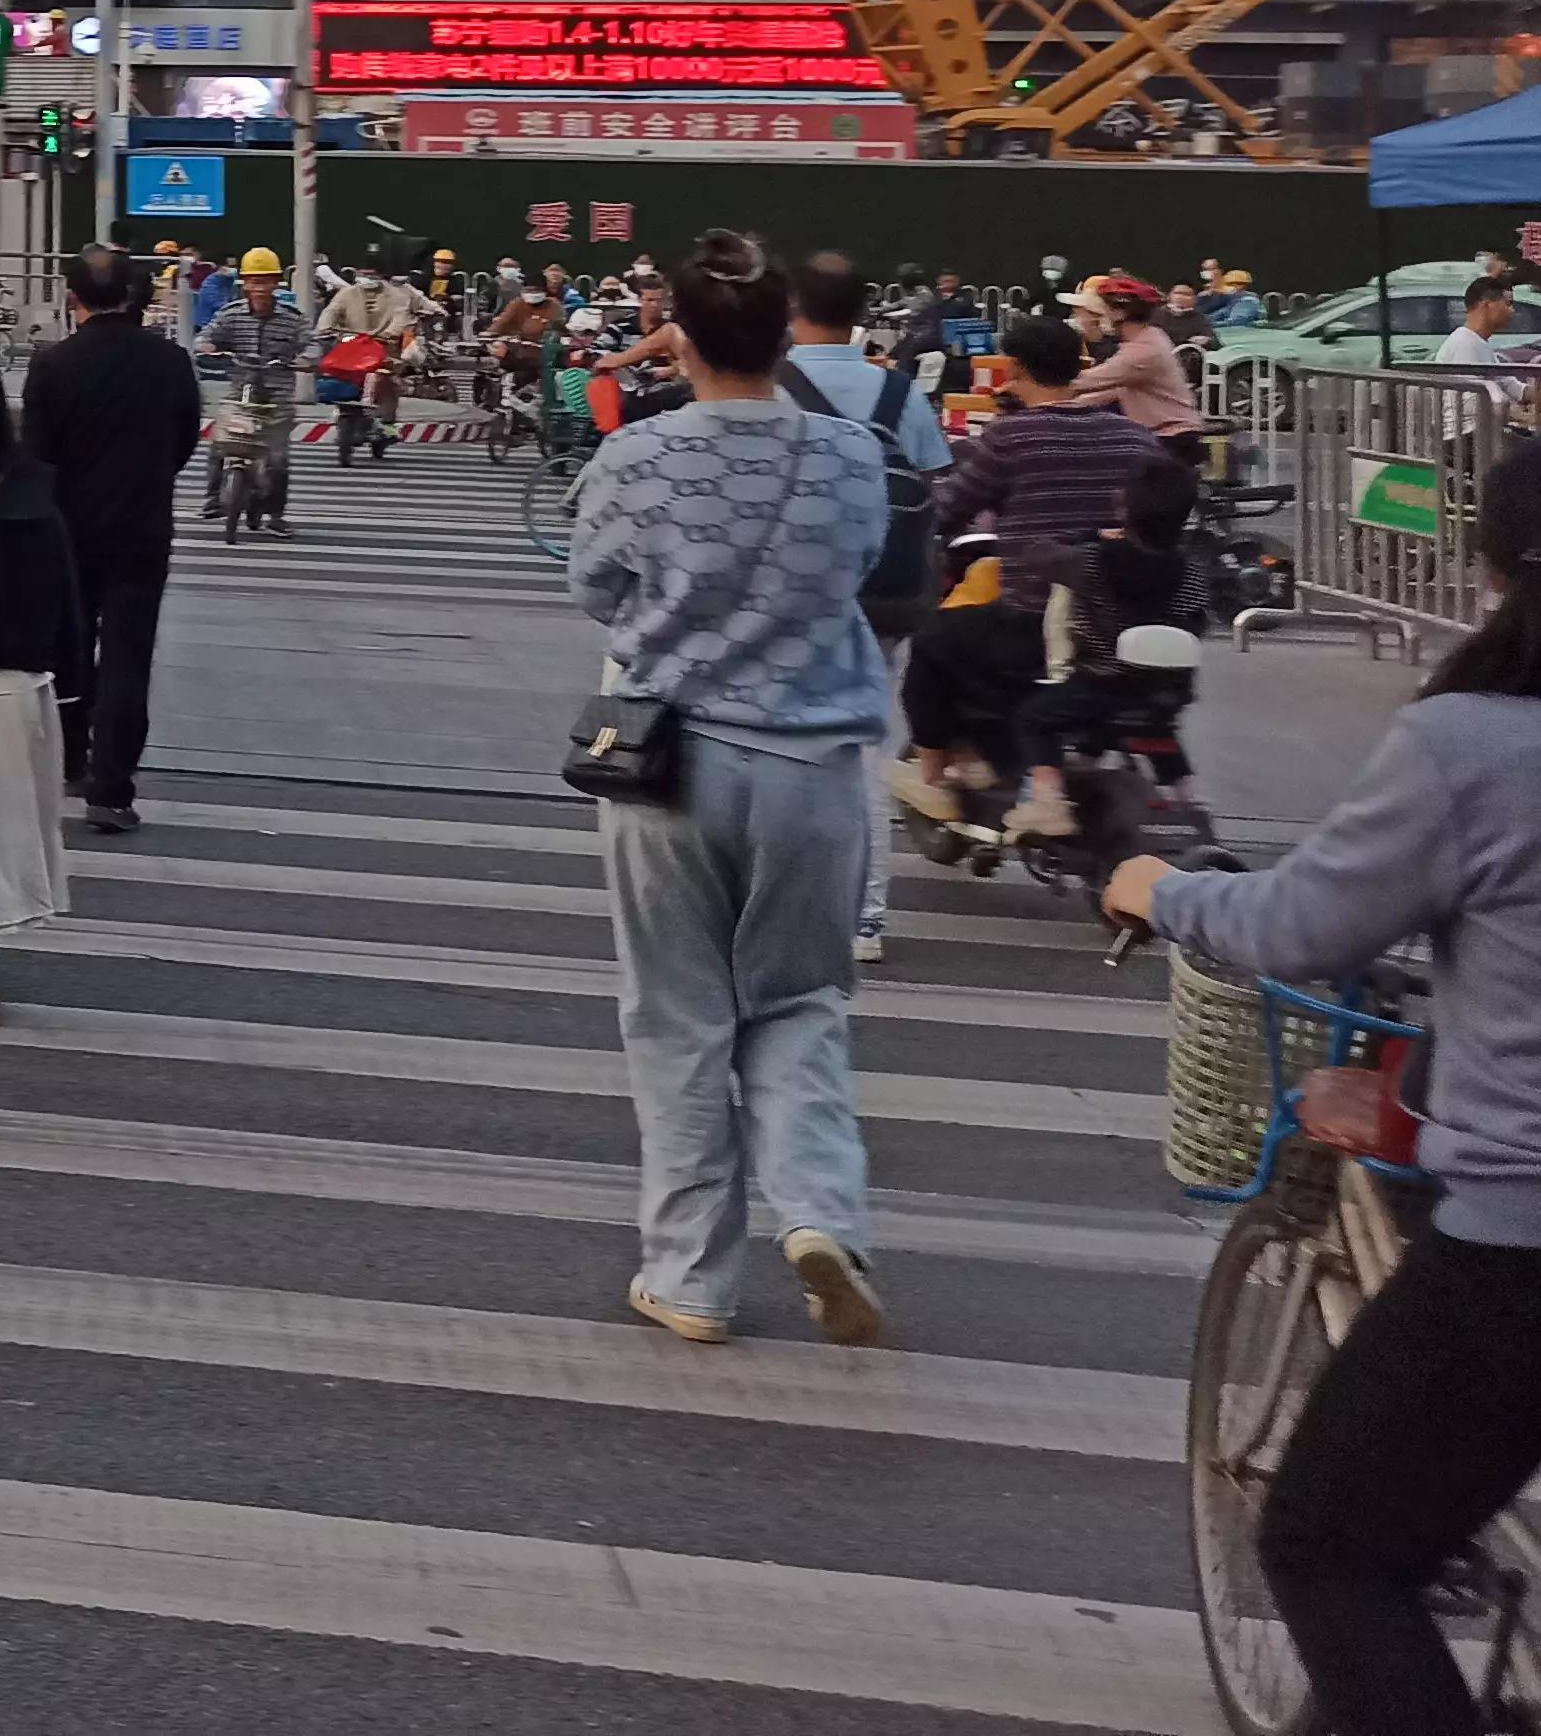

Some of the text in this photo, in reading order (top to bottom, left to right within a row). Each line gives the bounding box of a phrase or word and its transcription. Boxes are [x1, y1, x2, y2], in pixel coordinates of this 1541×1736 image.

[517, 110, 804, 141] 班前安全讲评台
[525, 200, 634, 243] 爱国
